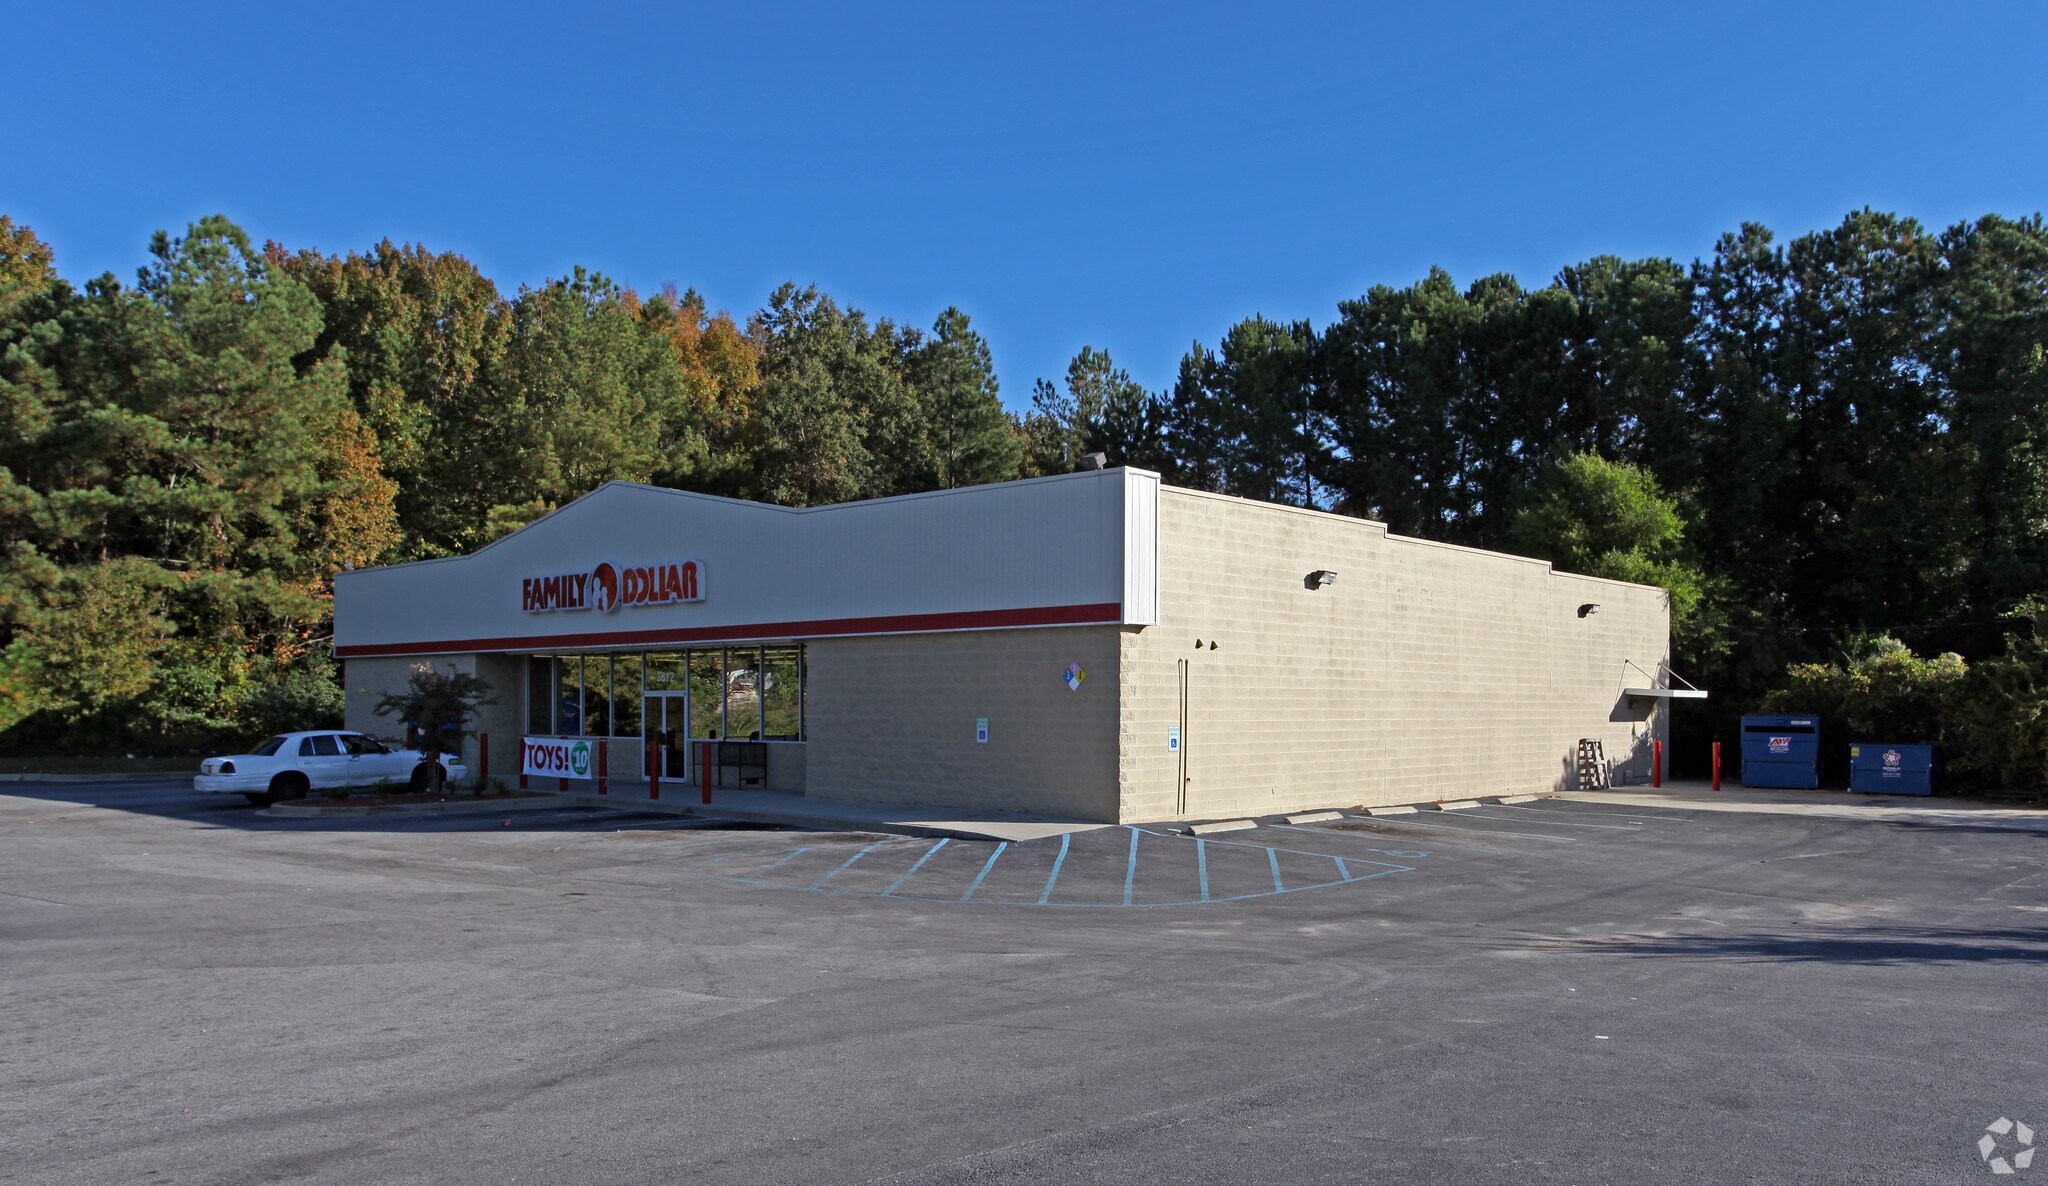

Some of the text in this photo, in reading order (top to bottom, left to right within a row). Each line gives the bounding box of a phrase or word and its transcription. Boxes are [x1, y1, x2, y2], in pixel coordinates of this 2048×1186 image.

[523, 561, 698, 611] FAMILY DOLLAR
[527, 745, 569, 771] TOYS!
